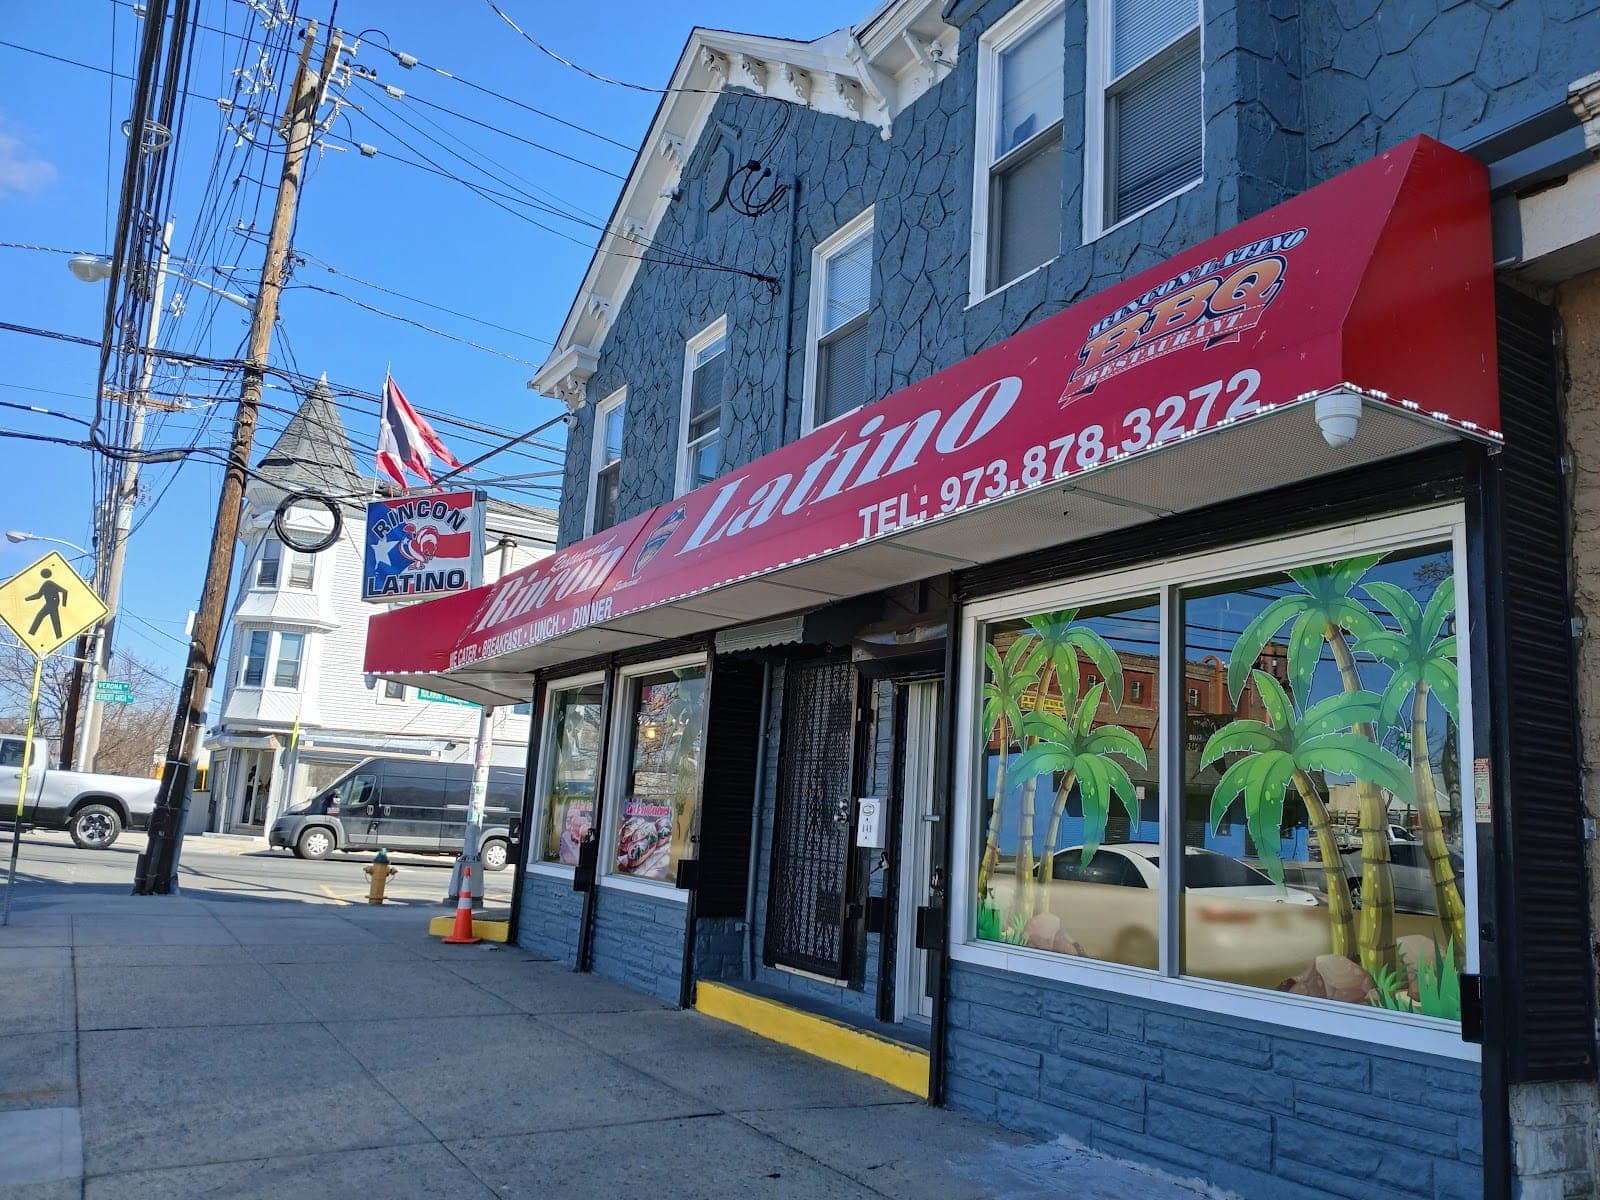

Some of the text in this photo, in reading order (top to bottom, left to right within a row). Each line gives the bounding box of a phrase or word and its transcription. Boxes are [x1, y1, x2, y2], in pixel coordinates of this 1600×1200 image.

[1078, 255, 1286, 373] BBQ
[1089, 228, 1308, 339] RINCON LATINO
[472, 376, 1022, 634] Rincon Latino
[858, 368, 1262, 539] TEL: 973.878.3272
[372, 500, 466, 539] RINCON
[367, 568, 466, 597] LATINO
[482, 628, 523, 657] BREAKFAST
[529, 615, 560, 643] LUNCH
[571, 596, 613, 629] DINNER
